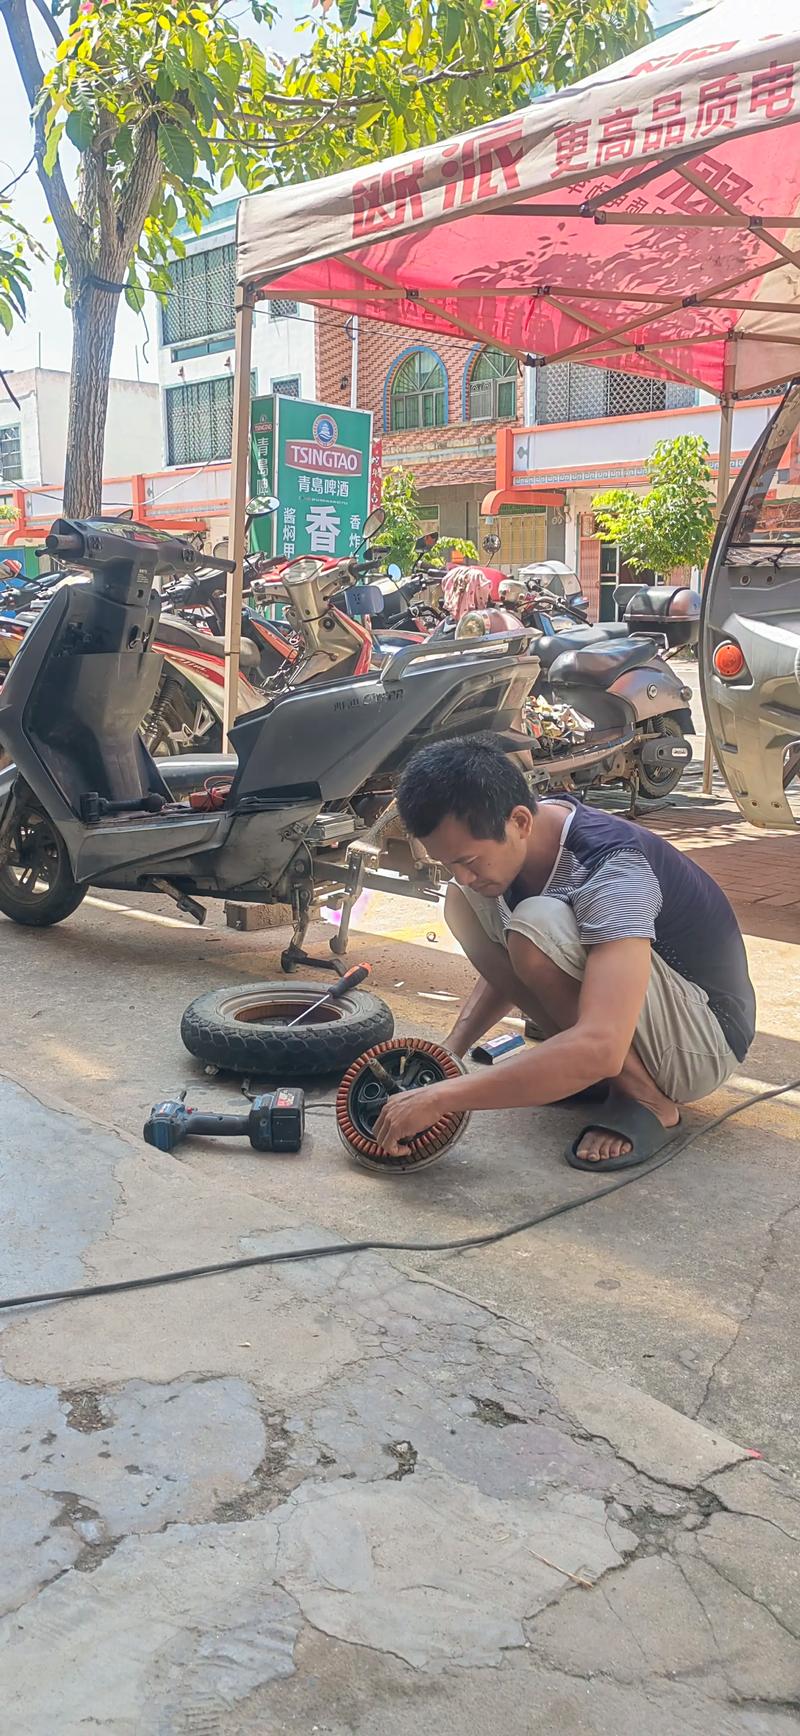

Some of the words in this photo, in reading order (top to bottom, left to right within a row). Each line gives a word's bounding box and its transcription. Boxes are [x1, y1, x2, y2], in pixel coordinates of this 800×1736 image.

[550, 60, 796, 179] 更高品质电
[291, 446, 358, 471] TSINGTAO
[305, 505, 341, 553] 香
